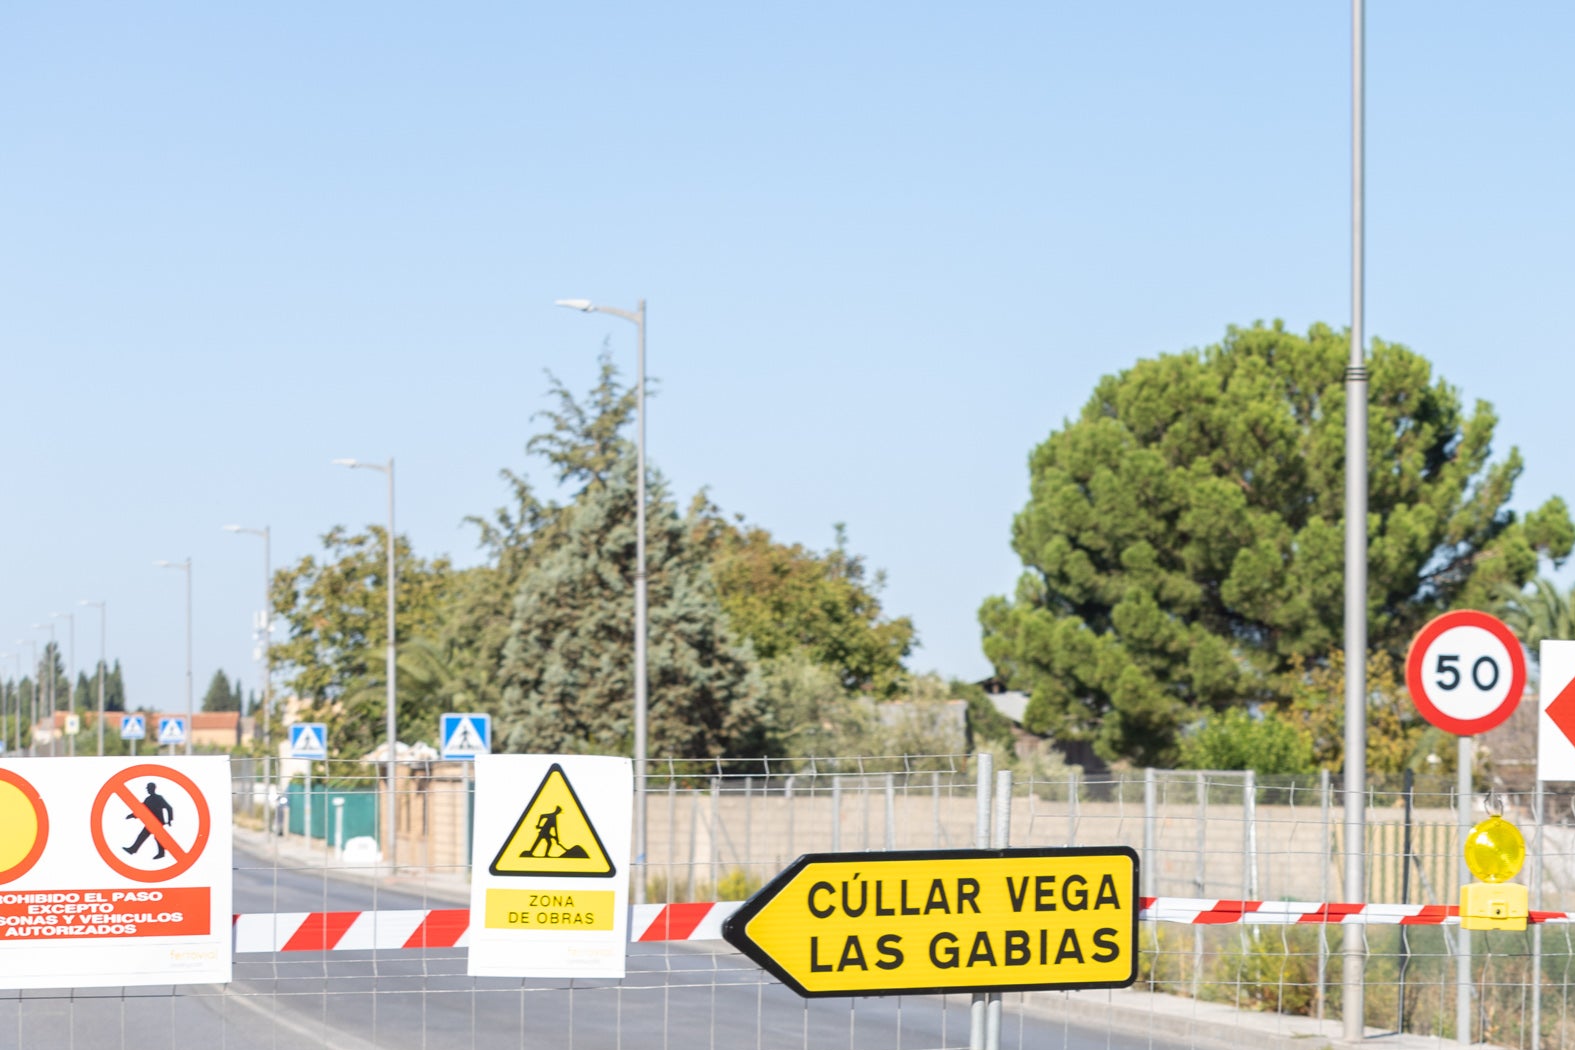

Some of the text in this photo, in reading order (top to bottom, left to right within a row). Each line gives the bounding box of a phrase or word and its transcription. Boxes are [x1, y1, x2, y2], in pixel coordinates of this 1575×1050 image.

[1436, 654, 1499, 691] 50
[0, 891, 163, 904] OHIBIDO EL PASO
[529, 895, 575, 907] ZONA
[807, 872, 1121, 919] CÚLLAR VEGA
[28, 903, 114, 915] EXCEPTO
[63, 915, 74, 924] Y
[80, 912, 183, 924] VEHICULOS
[508, 911, 595, 925] DE OBRAS
[5, 924, 137, 937] AUTORIZADOS
[810, 927, 1120, 972] LAS GABIAS
